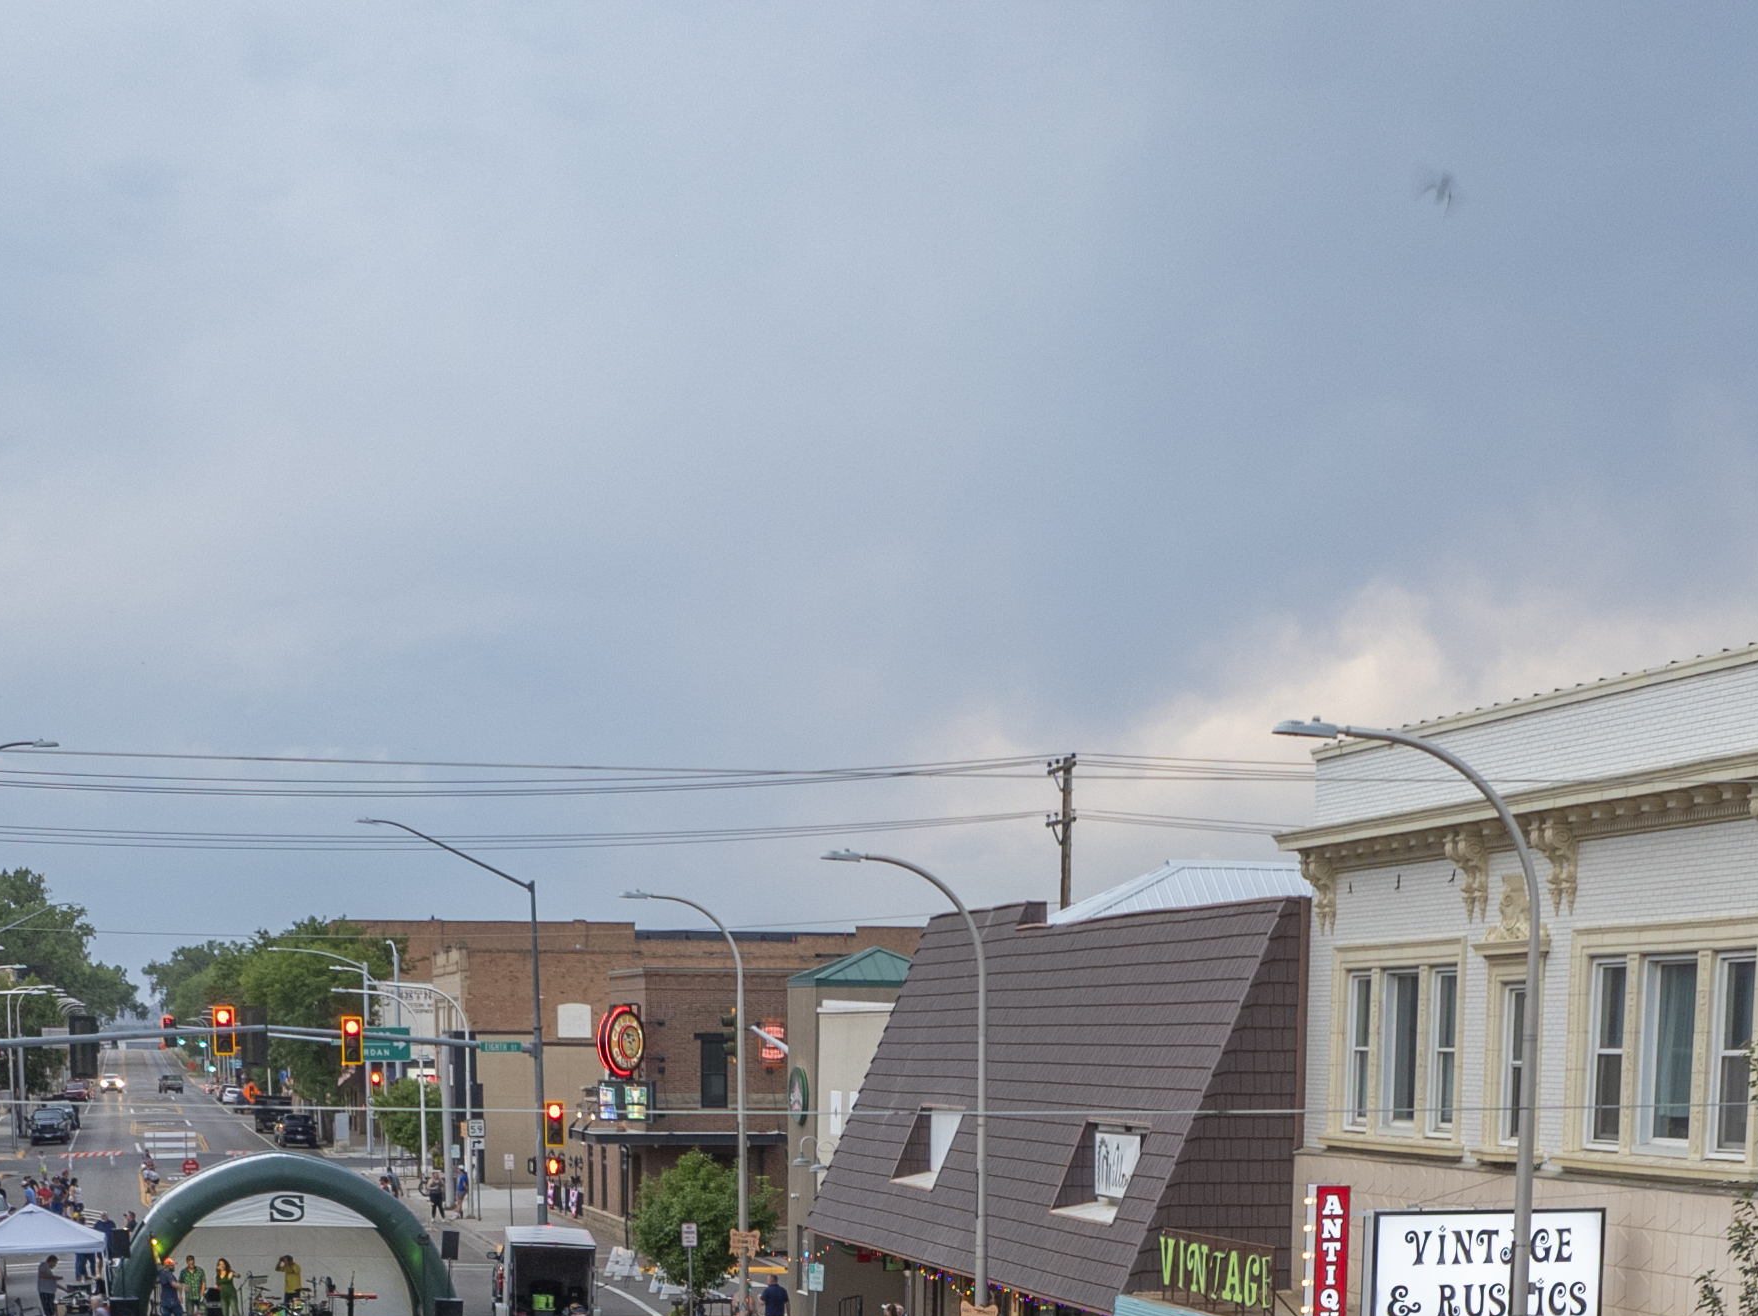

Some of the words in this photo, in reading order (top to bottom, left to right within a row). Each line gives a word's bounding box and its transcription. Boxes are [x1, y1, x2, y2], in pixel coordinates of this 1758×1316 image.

[363, 1048, 390, 1057] RDAN
[470, 1126, 483, 1134] 59
[1159, 1235, 1273, 1309] VINTAGE
